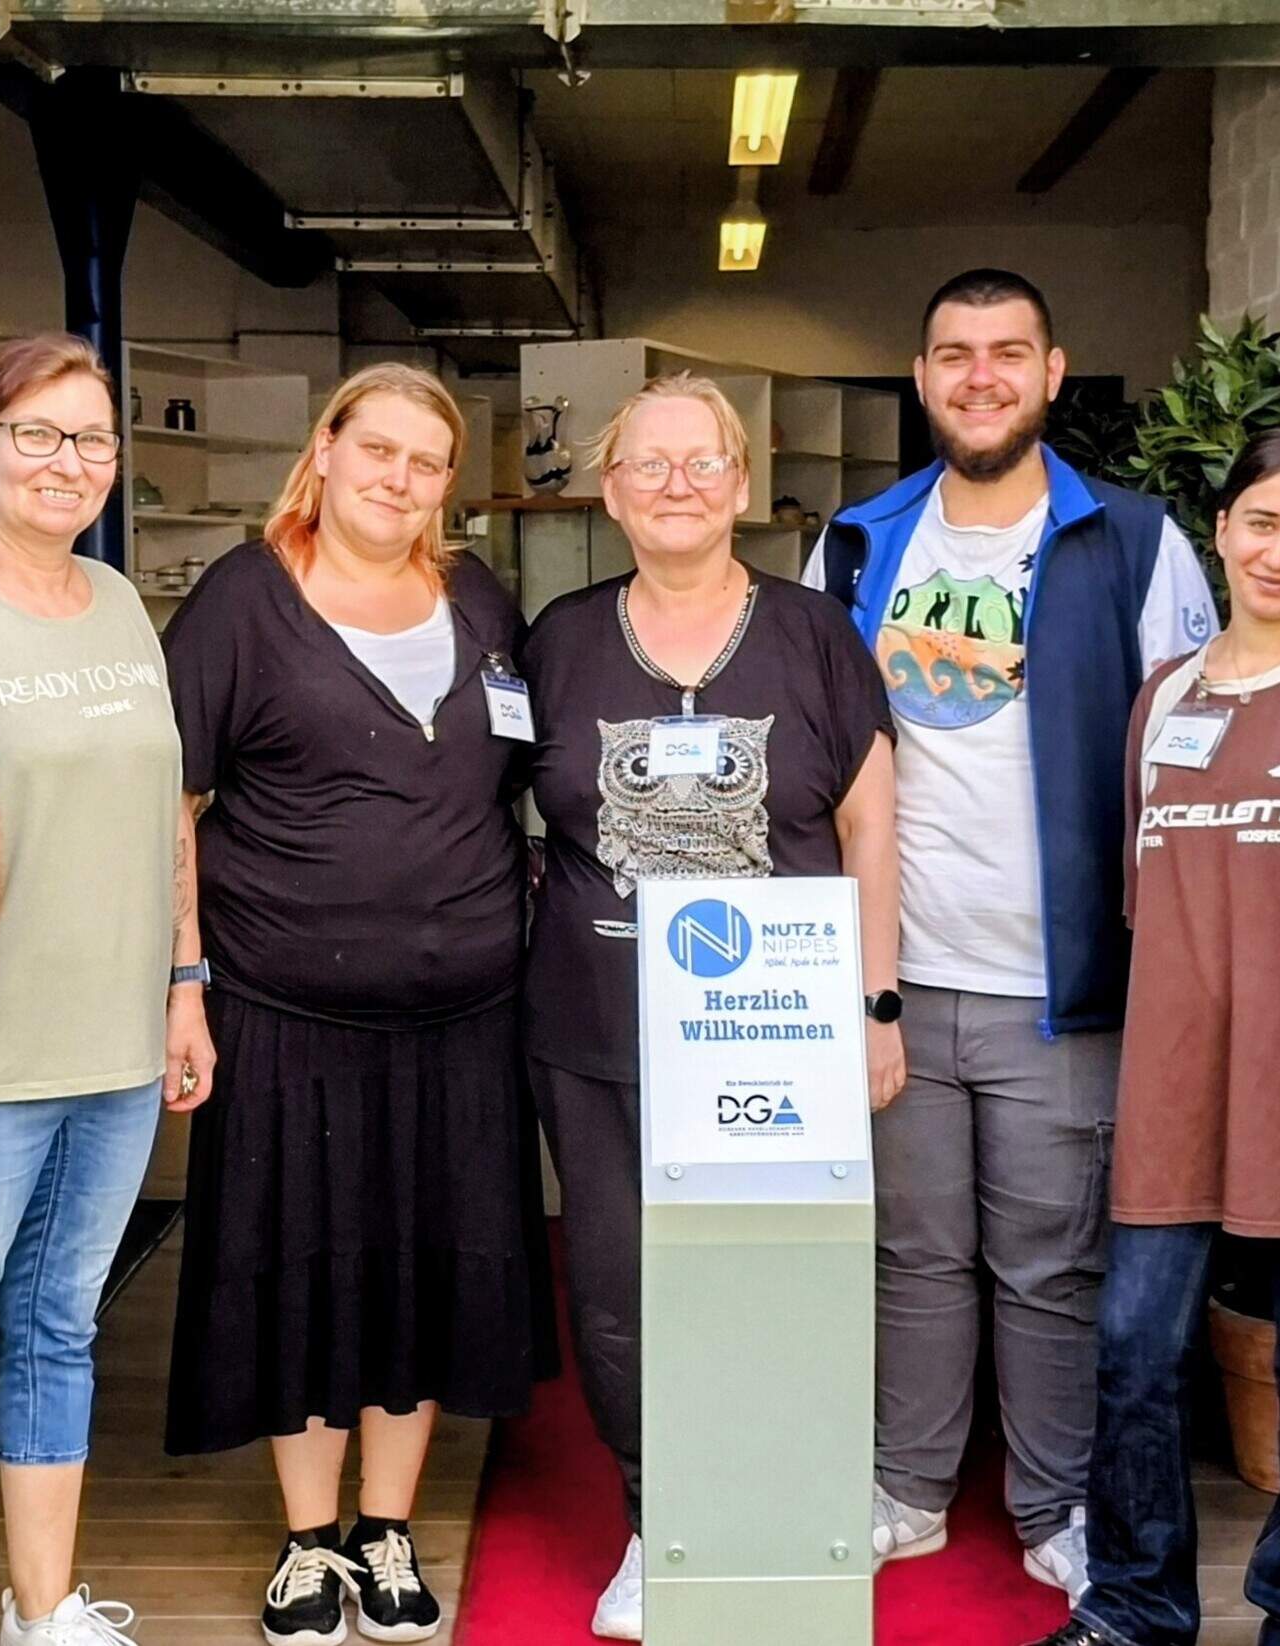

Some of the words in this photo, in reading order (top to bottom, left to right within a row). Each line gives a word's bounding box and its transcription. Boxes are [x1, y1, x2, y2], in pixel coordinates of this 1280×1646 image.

[80, 665, 116, 692] TO
[762, 923, 816, 936] NUTZ
[823, 922, 836, 936] &
[763, 939, 838, 953] NIPPES
[704, 990, 808, 1011] Herzlich
[680, 1020, 835, 1041] Willkommen
[718, 1094, 802, 1124] DGA
